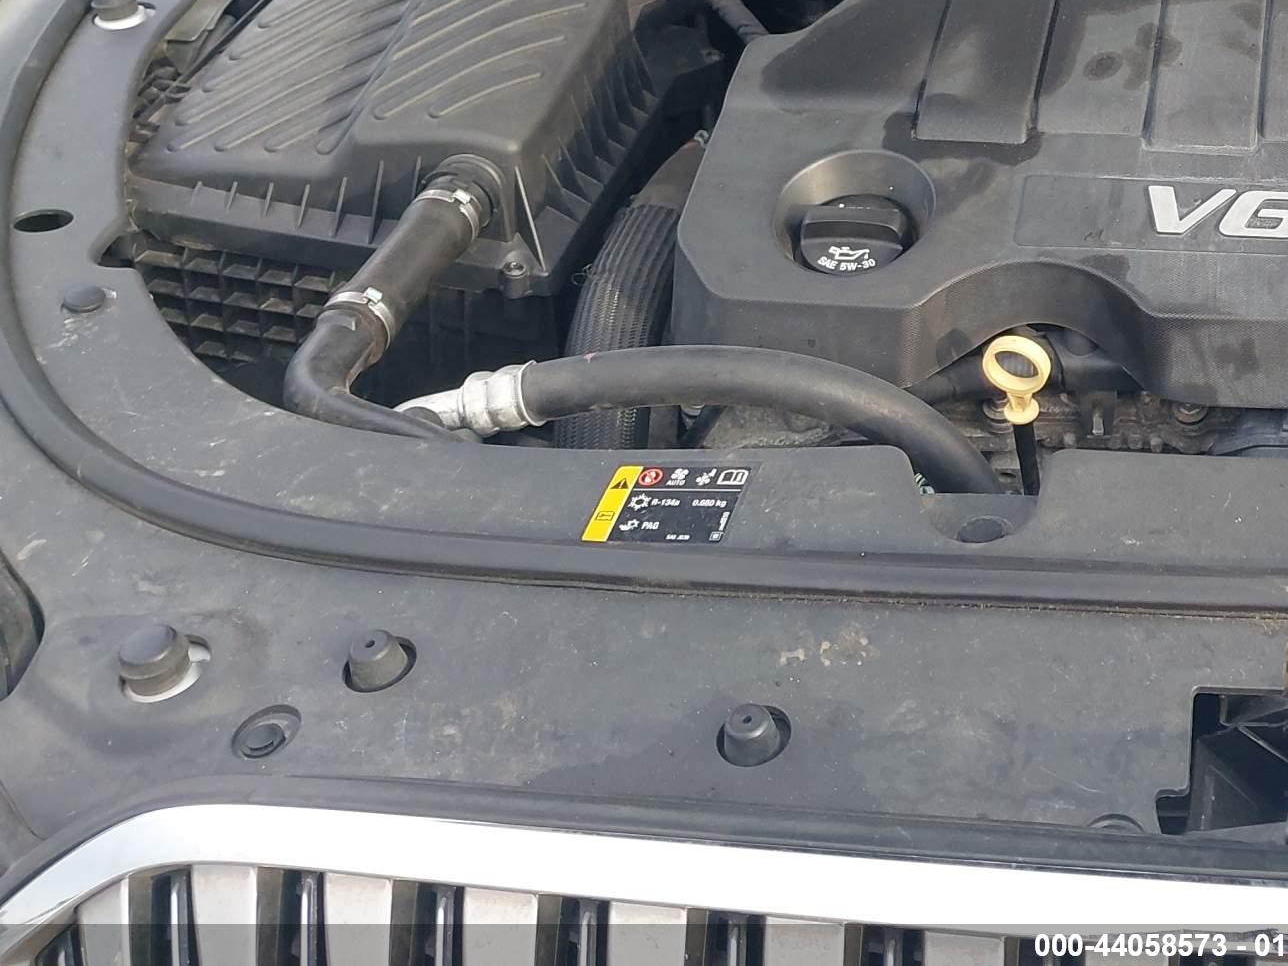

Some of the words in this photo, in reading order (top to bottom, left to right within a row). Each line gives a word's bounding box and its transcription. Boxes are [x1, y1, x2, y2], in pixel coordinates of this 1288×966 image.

[817, 256, 838, 270] SAE
[840, 258, 876, 271] 5W-30
[640, 521, 660, 530] PAG
